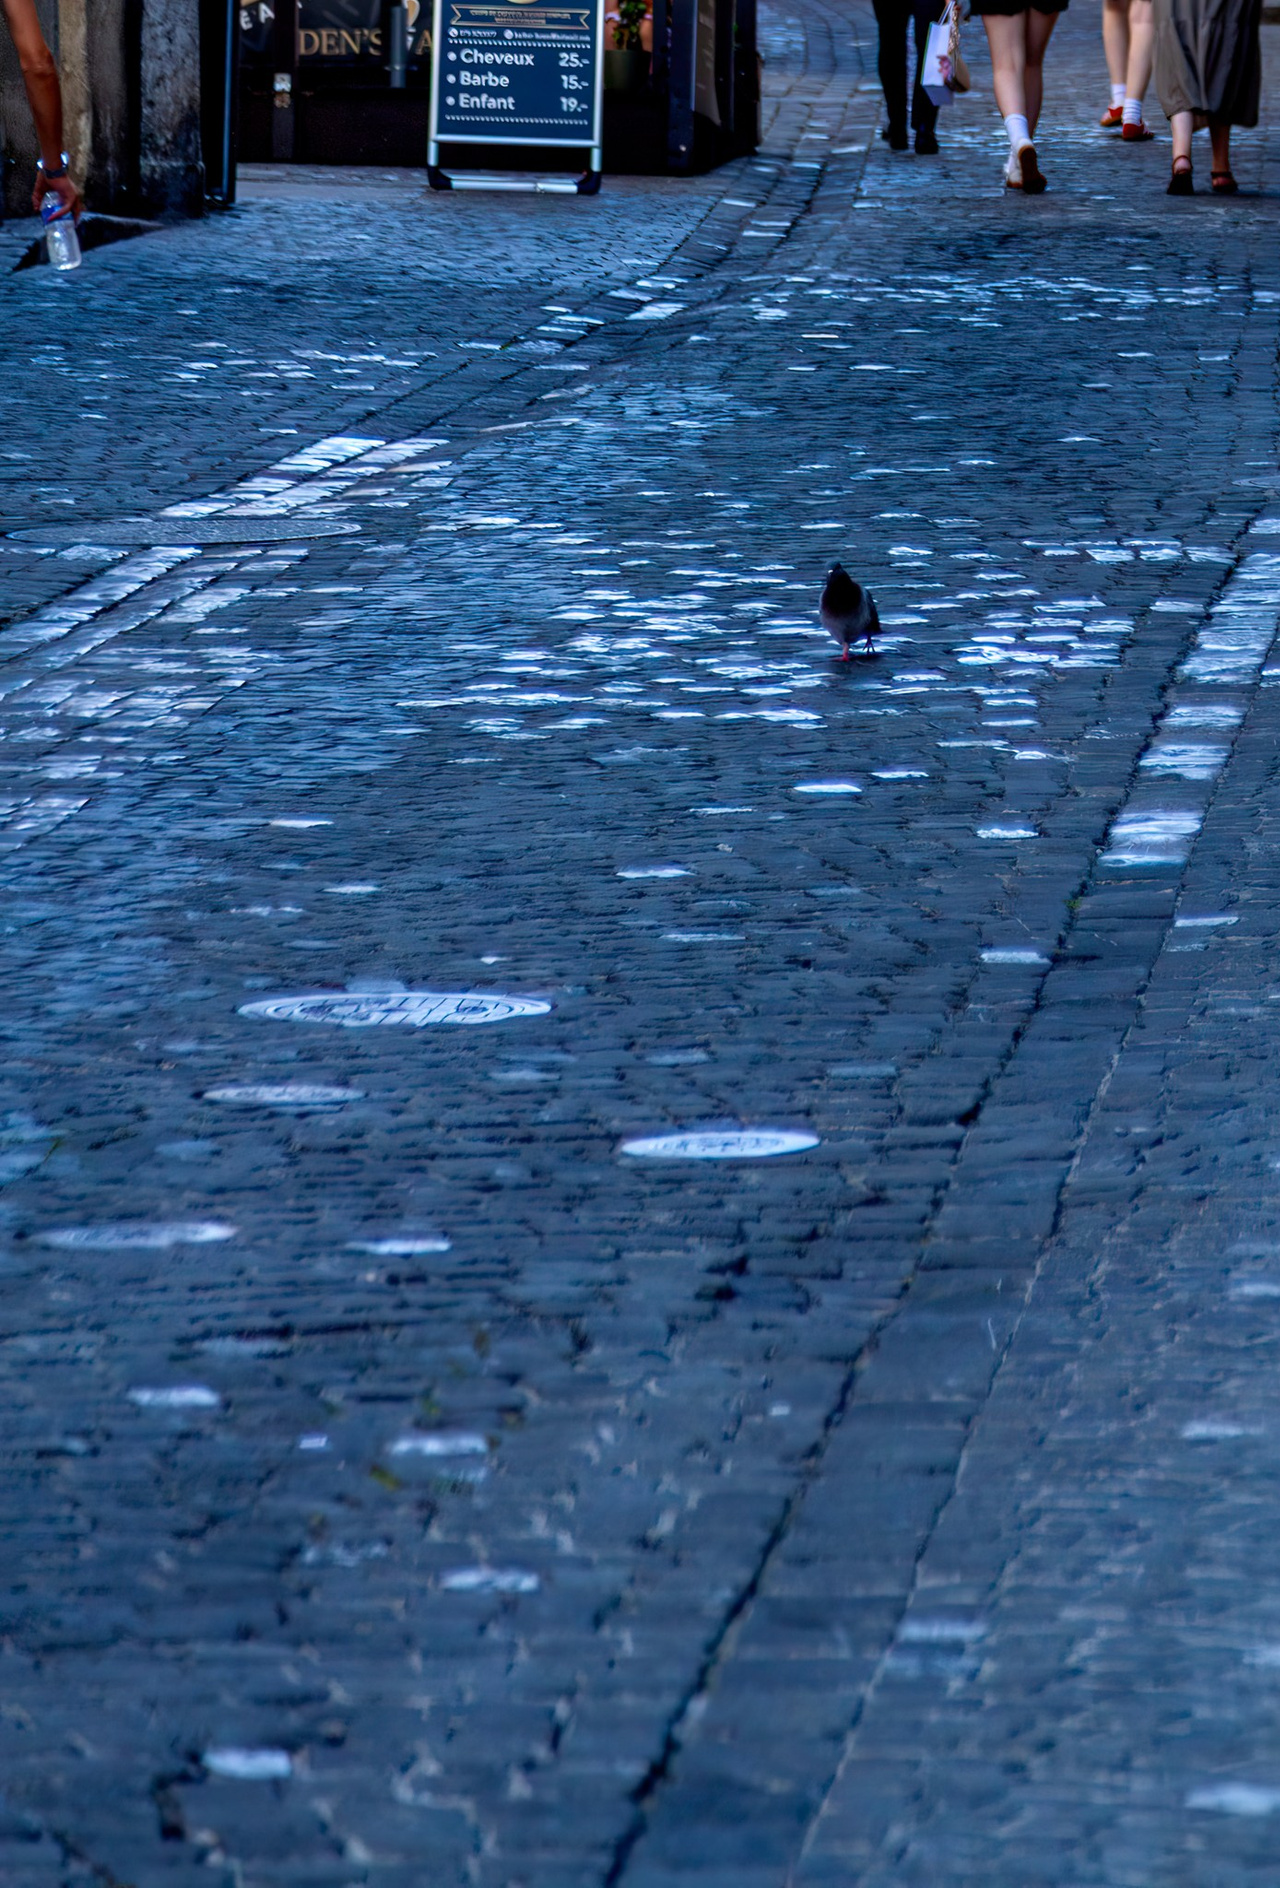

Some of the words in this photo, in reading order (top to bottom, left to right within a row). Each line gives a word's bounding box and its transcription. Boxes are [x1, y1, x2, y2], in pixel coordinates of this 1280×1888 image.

[300, 28, 382, 56] DEN'S
[460, 48, 534, 66] Cheveux
[558, 52, 590, 68] 25.-
[459, 70, 510, 88] Barbe
[560, 74, 589, 90] 15.-
[458, 92, 515, 110] Enfant
[559, 96, 588, 112] 19.-
